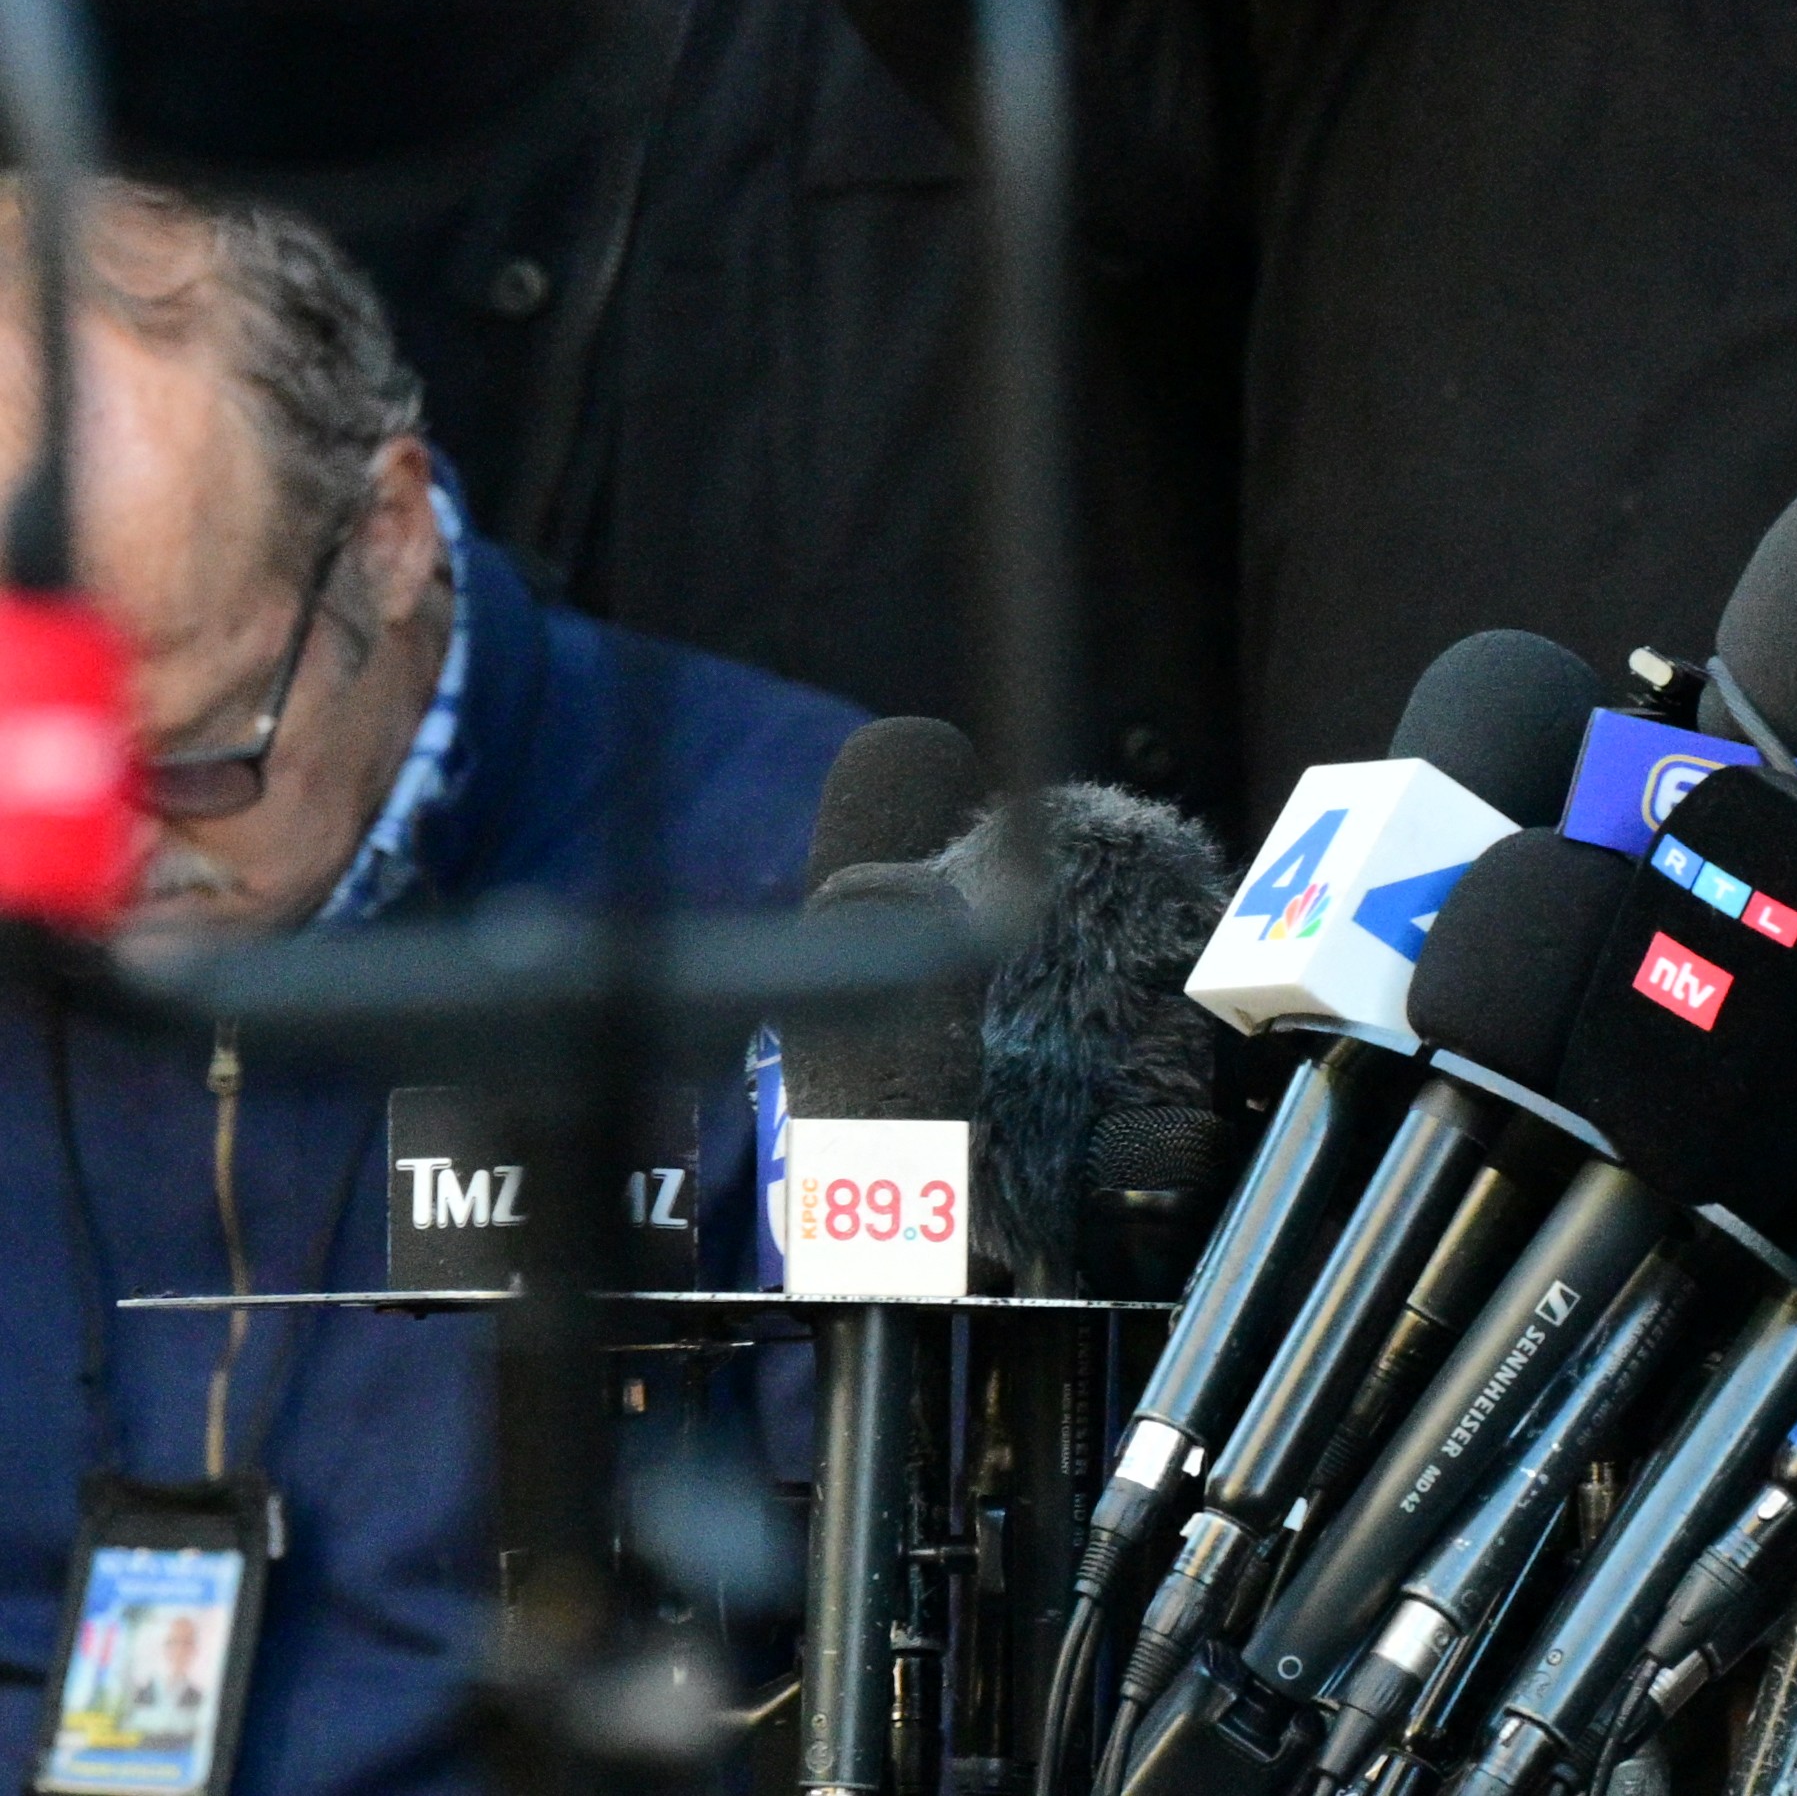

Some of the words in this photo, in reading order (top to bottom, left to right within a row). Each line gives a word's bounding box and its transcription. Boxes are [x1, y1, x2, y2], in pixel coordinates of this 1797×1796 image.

[1234, 809, 1349, 940] 4
[1664, 846, 1783, 934] RTL
[1648, 955, 1716, 1011] ntv
[395, 1157, 528, 1230] TMZ
[801, 1178, 818, 1240] KPCC
[825, 1179, 955, 1243] 89.3
[1439, 1322, 1546, 1462] SENNHEISER
[1398, 1488, 1423, 1515] 42
[1412, 1462, 1440, 1494] MD
